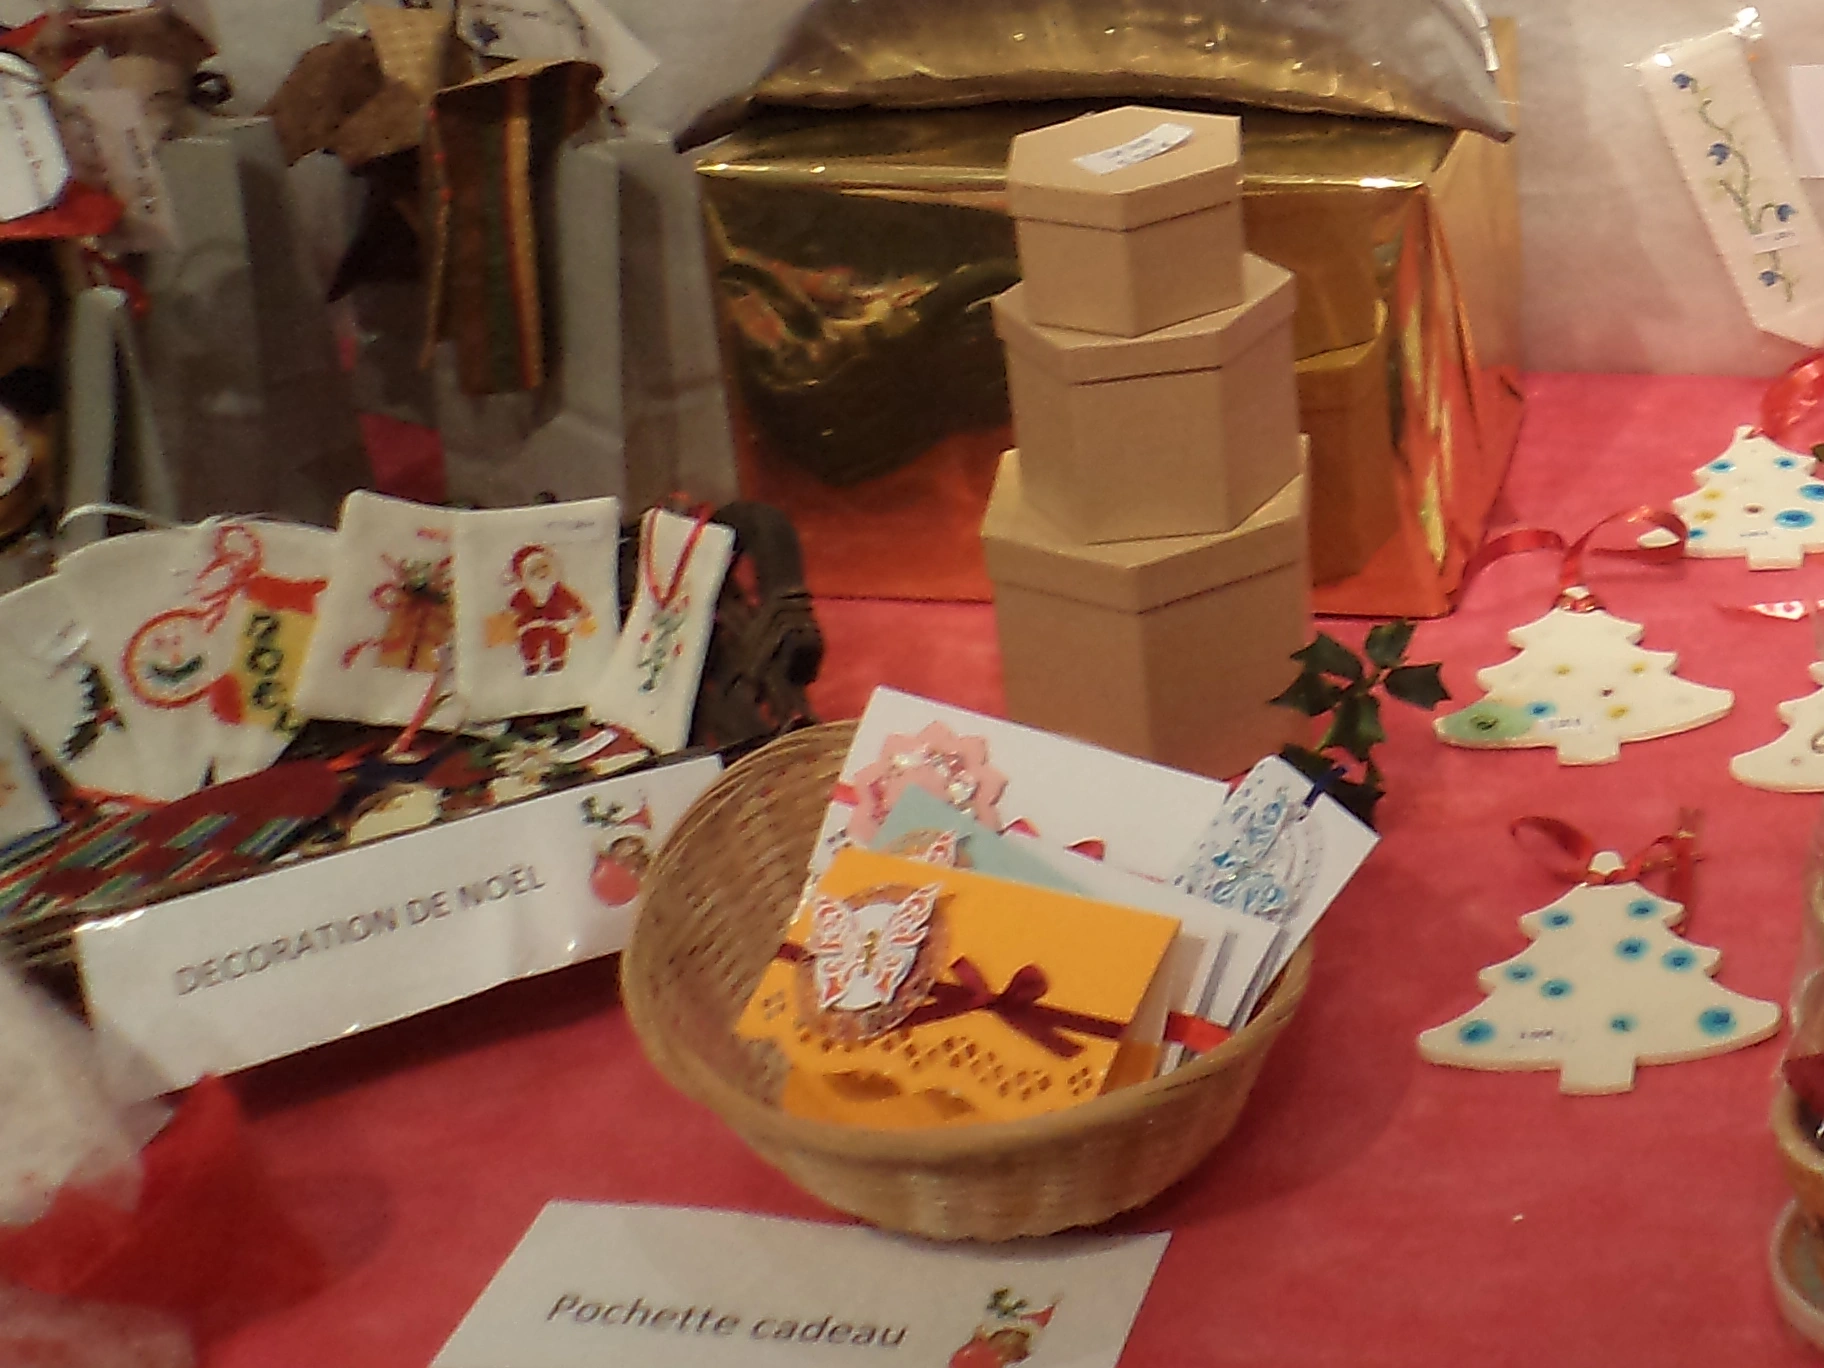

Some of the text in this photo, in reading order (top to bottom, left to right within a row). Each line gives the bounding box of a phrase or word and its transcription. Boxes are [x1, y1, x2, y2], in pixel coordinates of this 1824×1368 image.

[174, 906, 400, 996] DECORATION
[405, 889, 453, 926] DE
[546, 1294, 909, 1346] Pochette cadeau
